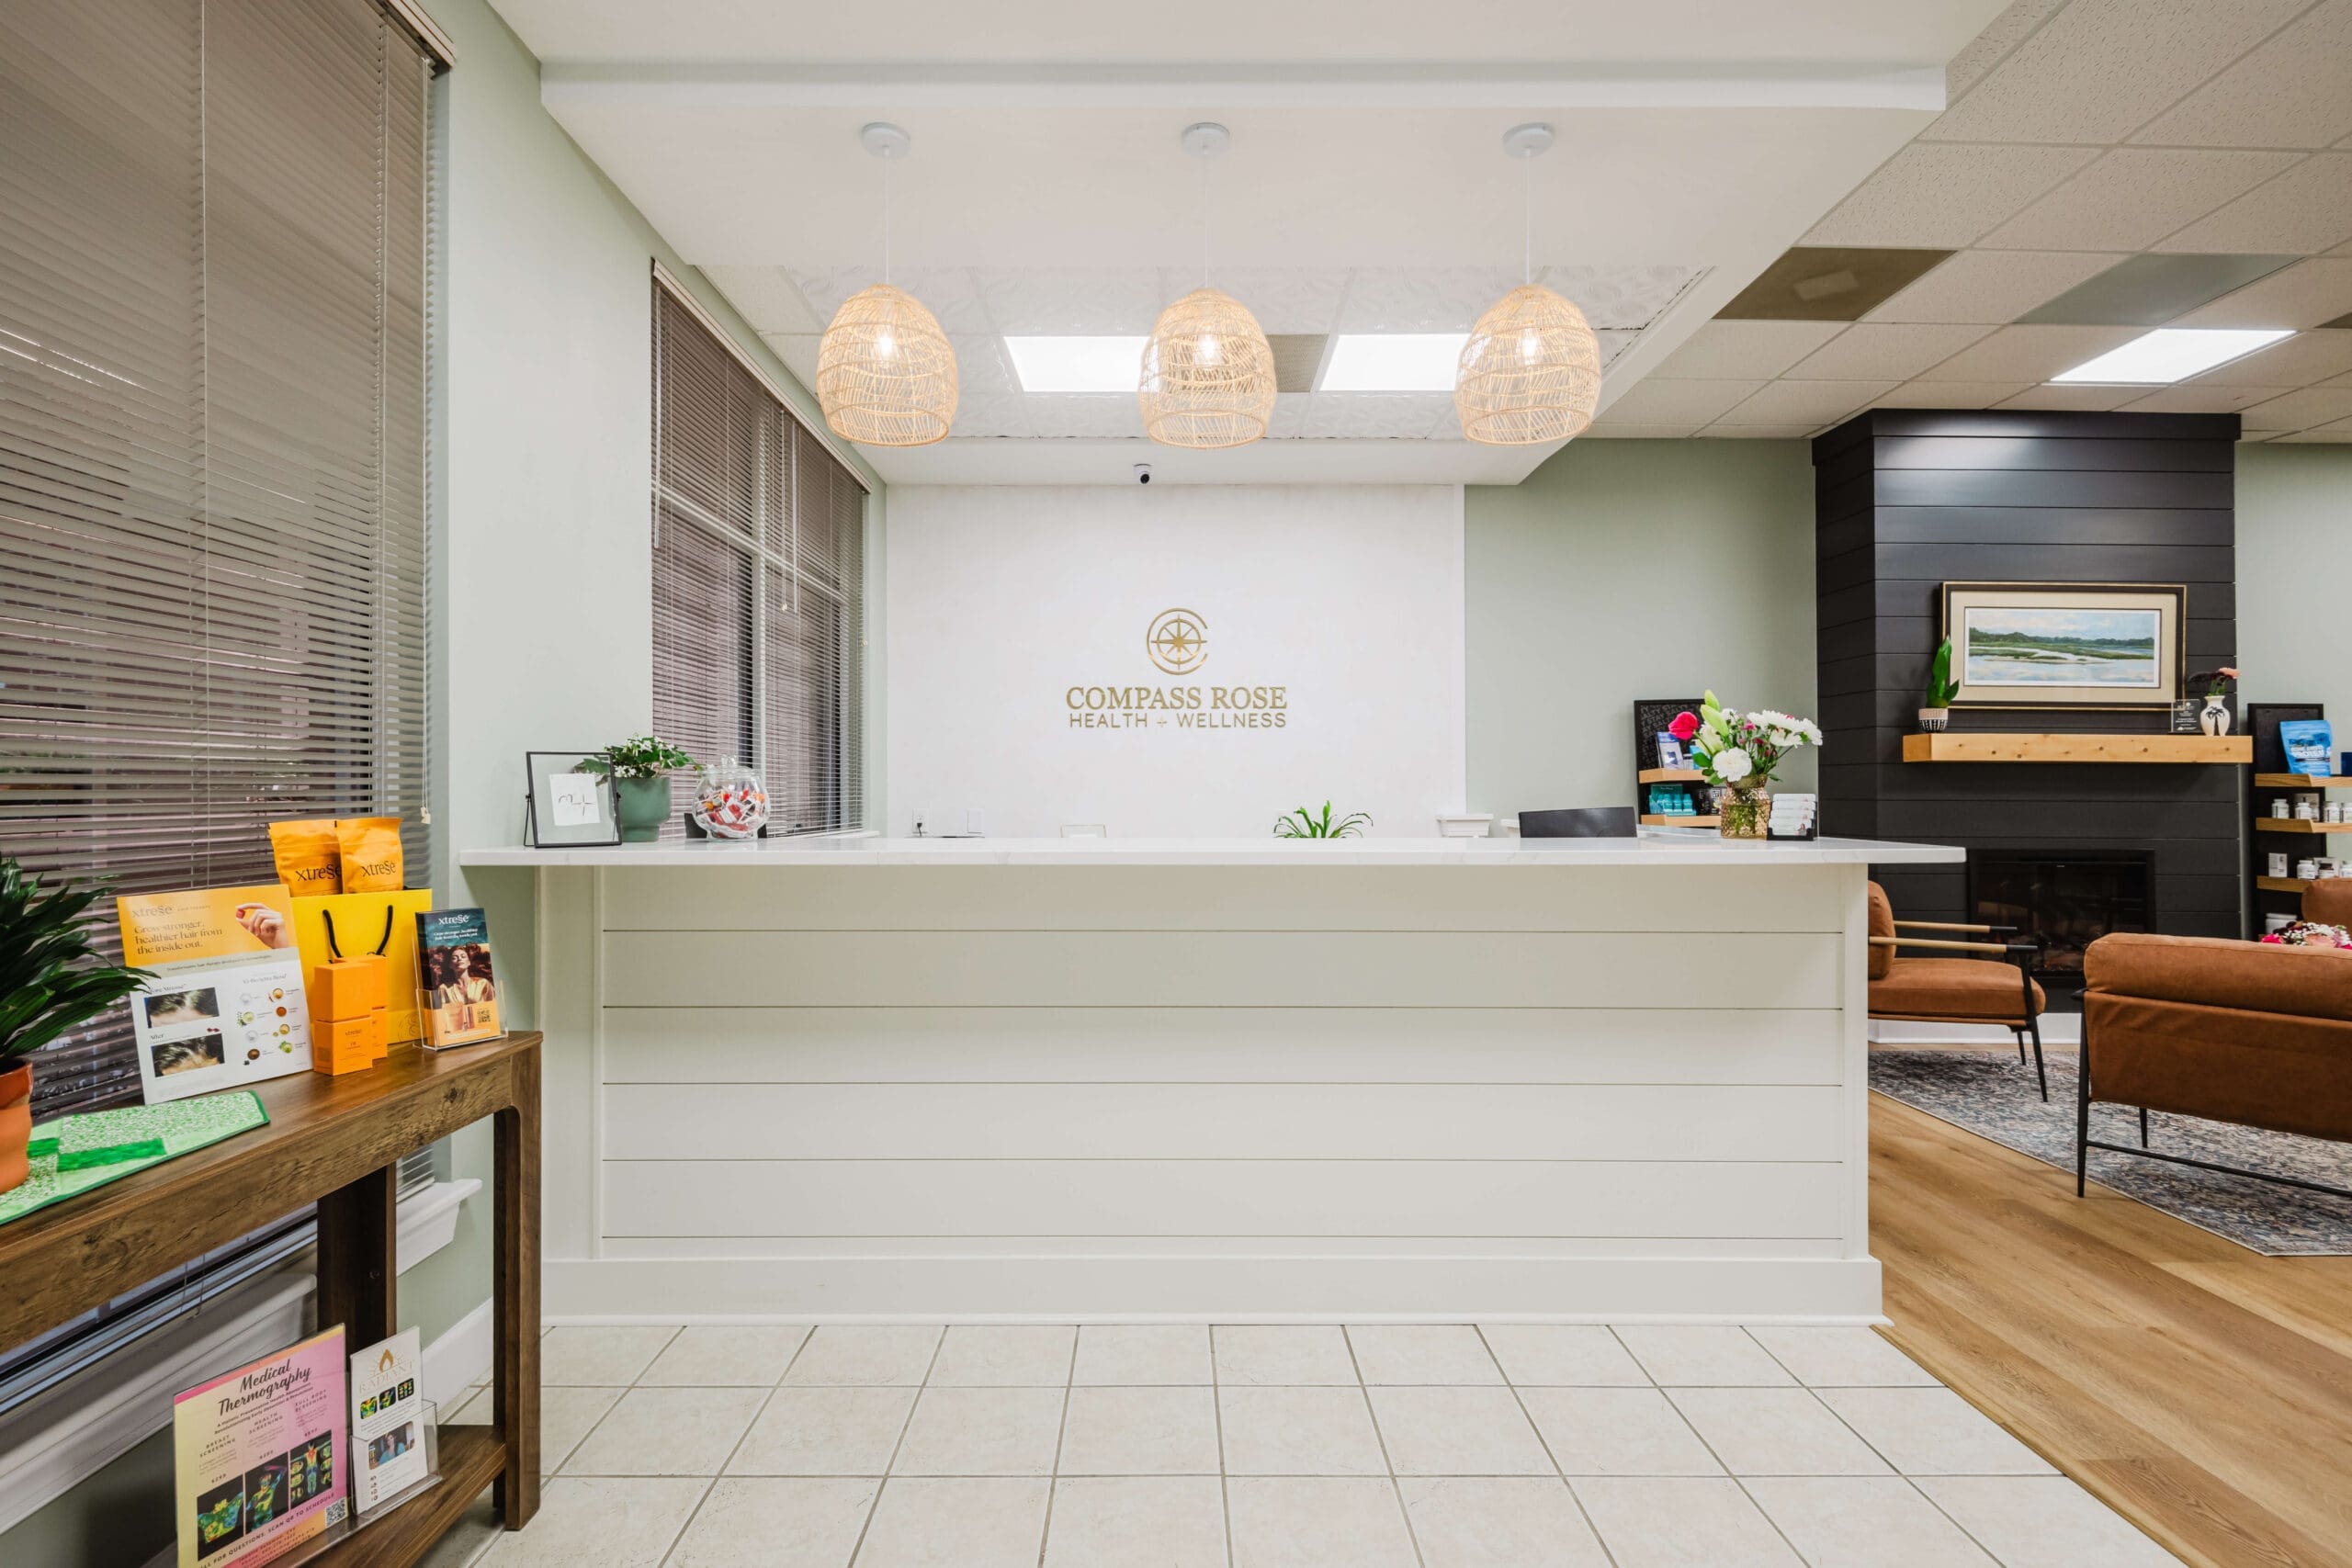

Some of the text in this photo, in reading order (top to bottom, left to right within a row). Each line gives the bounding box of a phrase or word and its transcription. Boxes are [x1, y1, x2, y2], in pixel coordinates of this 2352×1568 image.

[1066, 686, 1287, 710] COMPASS ROSE
[1069, 713, 1148, 728] HEALTH
[1176, 712, 1286, 728] WELLNESS
[134, 924, 160, 934] Grow
[135, 929, 222, 944] healthier hair from
[137, 945, 154, 954] the
[155, 942, 183, 953] inside
[240, 1359, 291, 1393] Medical
[218, 1368, 311, 1416] Thermography
[268, 1520, 285, 1532] SCAN
[286, 1515, 294, 1523] QR
[296, 1509, 304, 1517] TO
[305, 1493, 334, 1512] SCHEDULE
